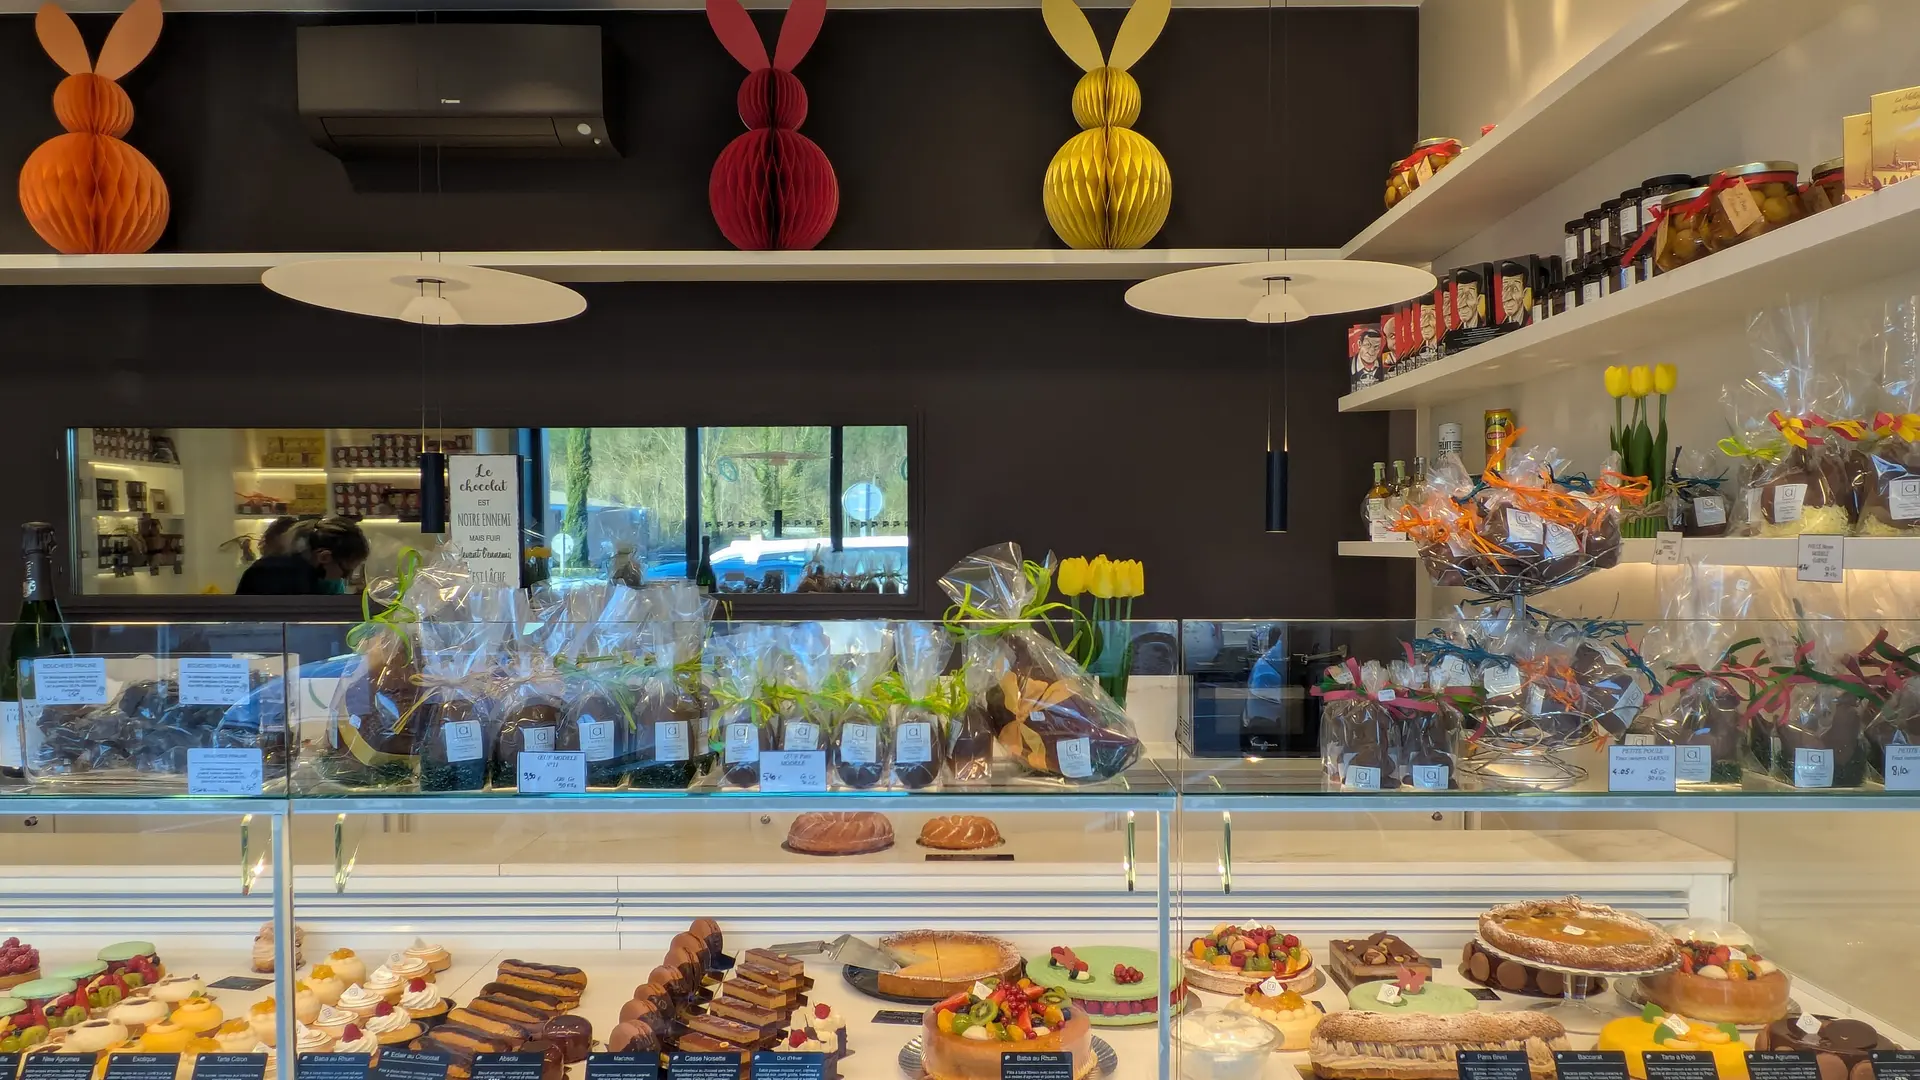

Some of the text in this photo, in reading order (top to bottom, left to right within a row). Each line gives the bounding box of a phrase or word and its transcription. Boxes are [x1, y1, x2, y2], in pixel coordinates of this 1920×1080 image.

[475, 464, 493, 478] Le
[460, 479, 508, 492] chocolat
[458, 513, 511, 527] NOTRE ENNEMI
[1775, 1054, 1800, 1062] Agrumes
